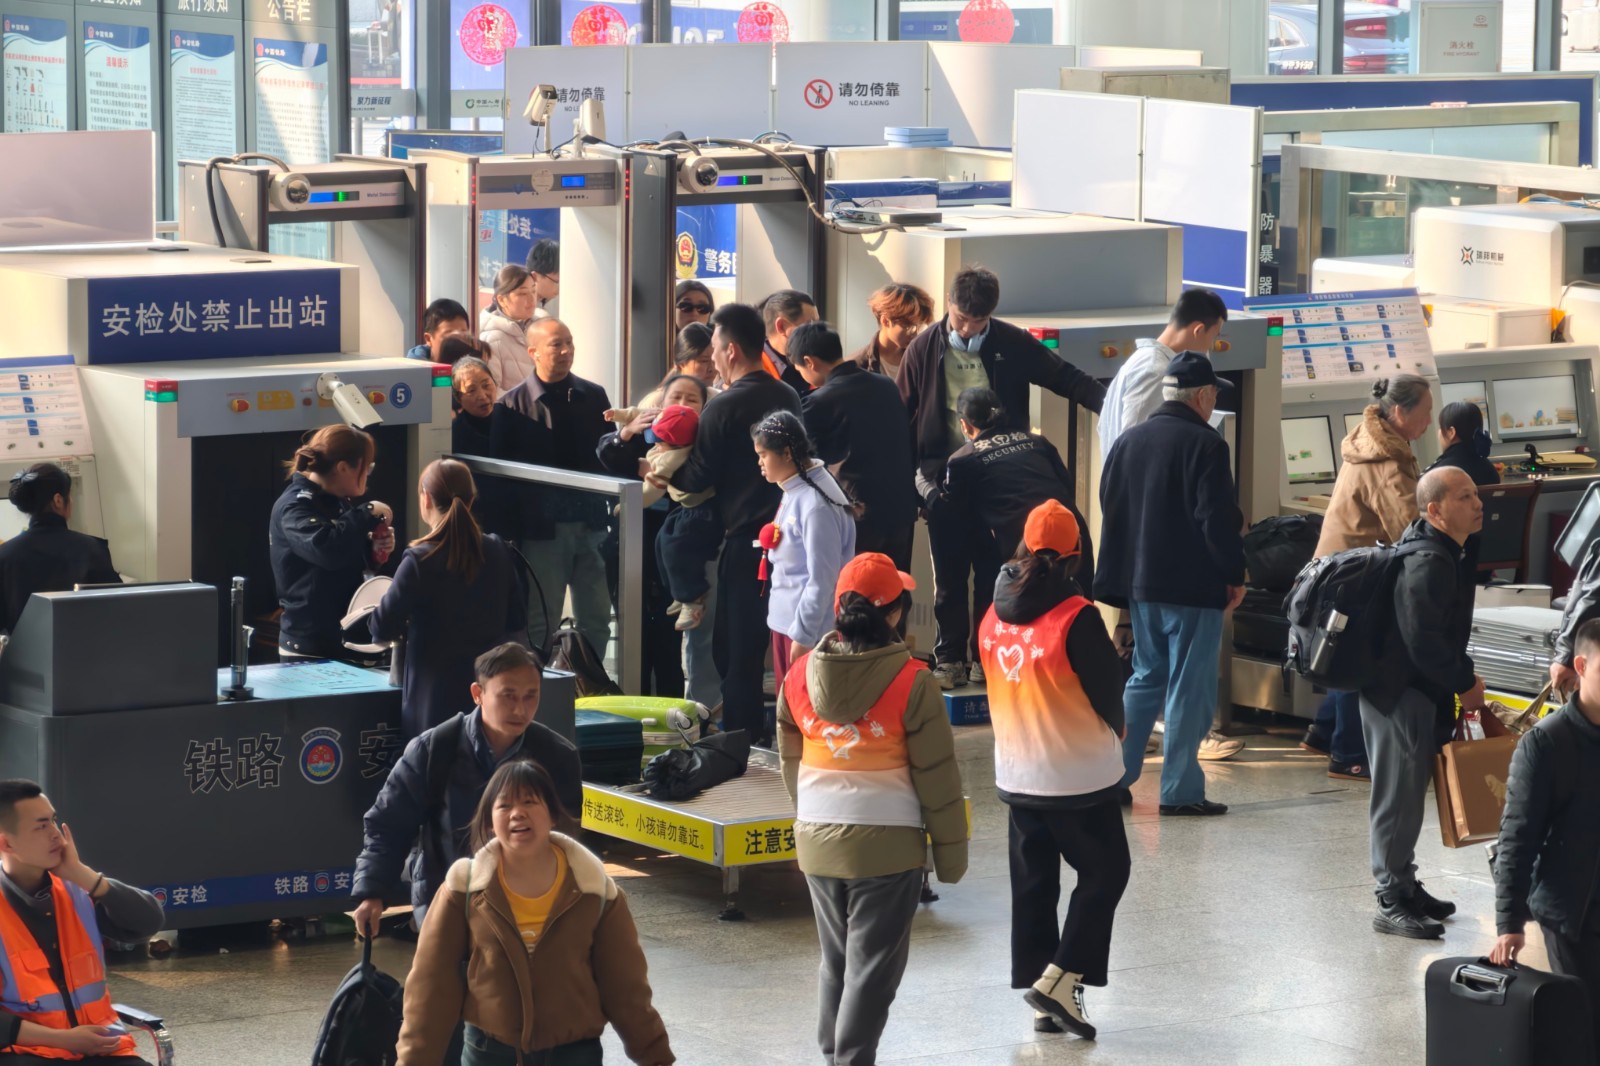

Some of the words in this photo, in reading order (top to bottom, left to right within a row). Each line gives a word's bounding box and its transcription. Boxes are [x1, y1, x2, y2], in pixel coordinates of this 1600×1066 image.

[267, 0, 311, 22] 公告栏
[838, 82, 900, 97] 请勿倚靠
[1259, 213, 1275, 295] 防暴器
[102, 294, 328, 337] 安检处禁止出站
[395, 388, 406, 404] 5
[981, 441, 1035, 464] SECURITY
[184, 732, 285, 794] 铁路
[172, 884, 208, 906] 安检
[274, 875, 309, 896] 铁路
[334, 871, 350, 890] 安
